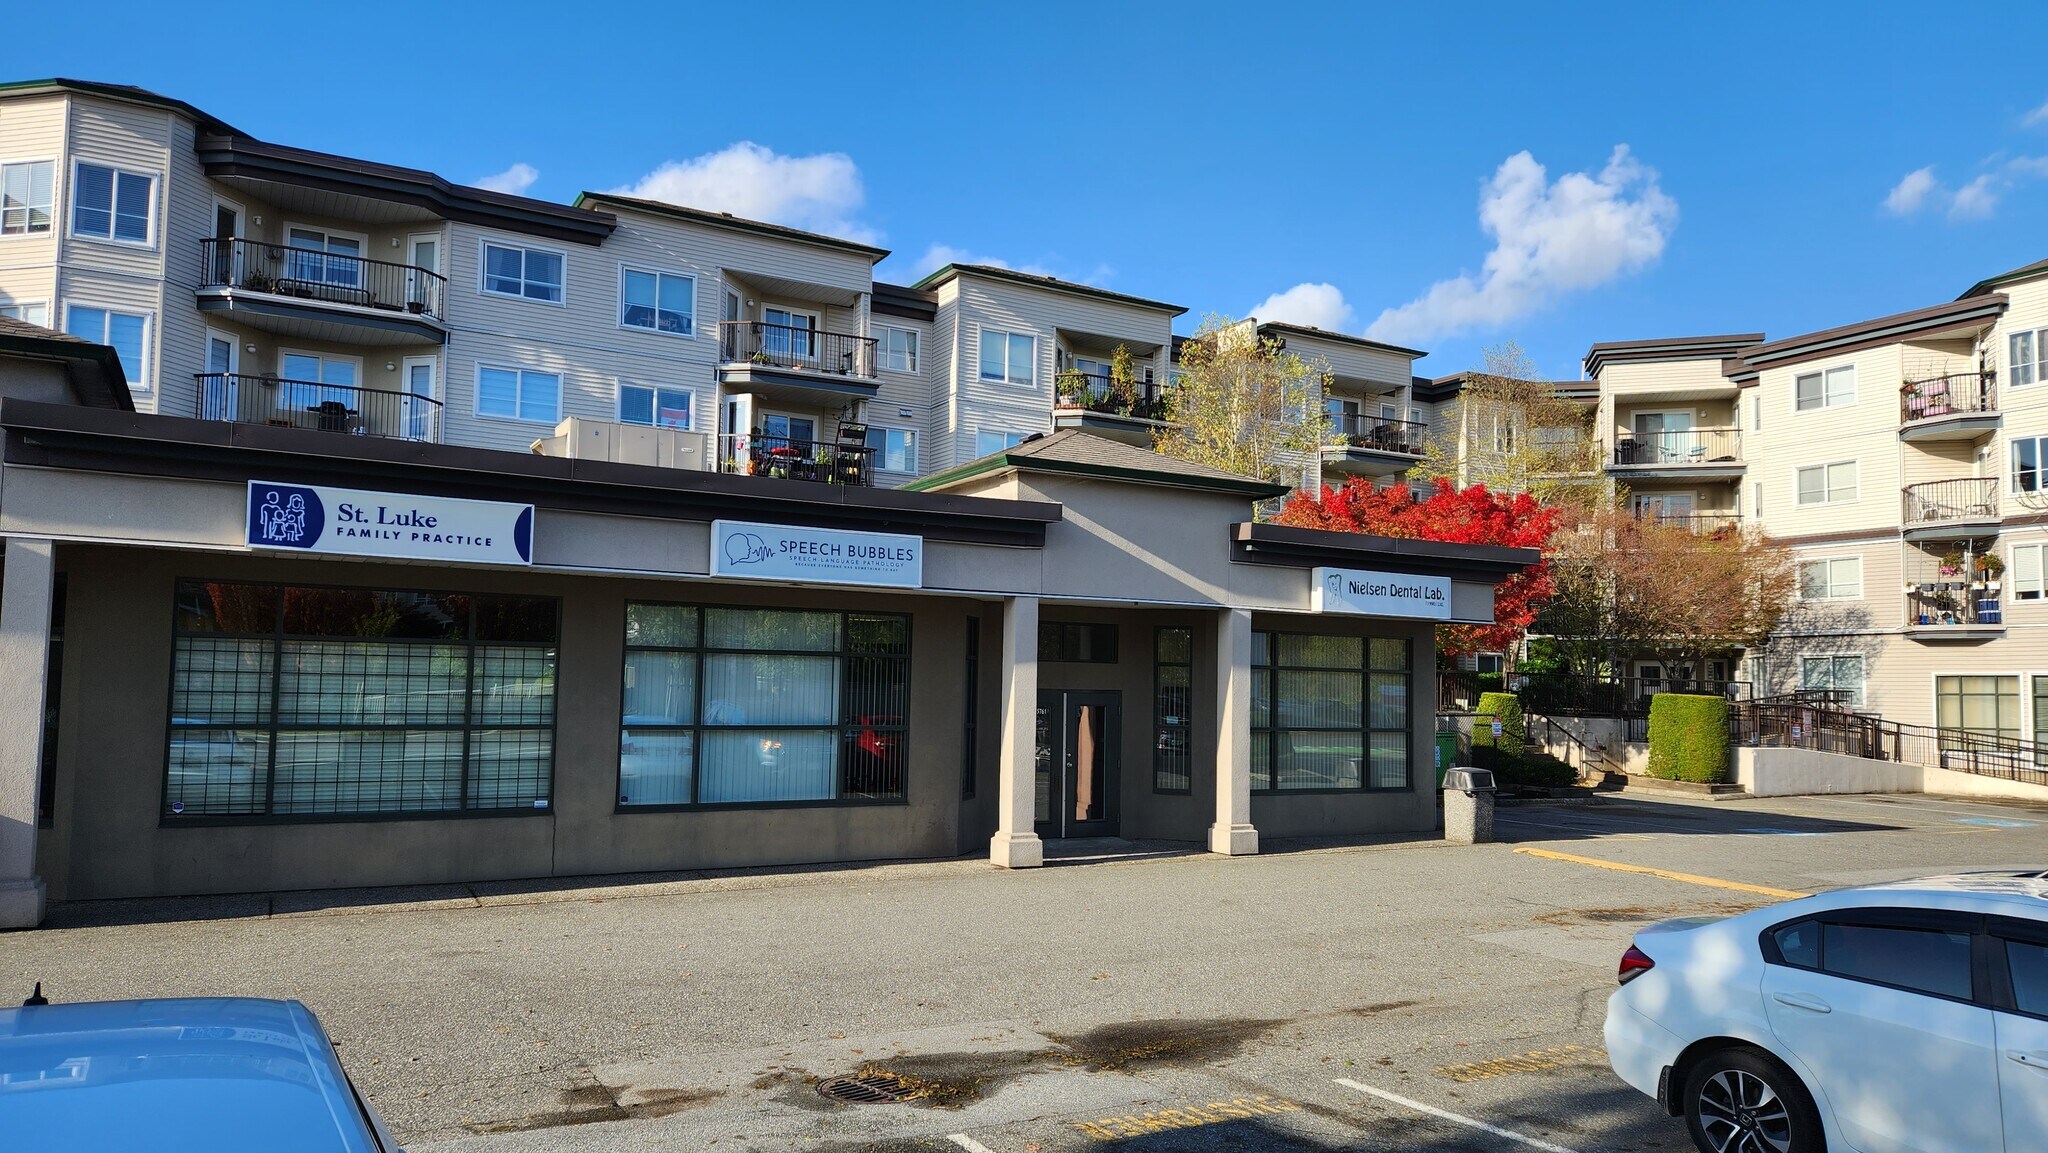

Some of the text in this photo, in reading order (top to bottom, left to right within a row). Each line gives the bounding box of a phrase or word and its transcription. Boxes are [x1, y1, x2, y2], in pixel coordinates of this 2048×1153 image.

[337, 502, 438, 528] St. Luke
[336, 526, 492, 547] FAMILY PRACTICE
[779, 540, 914, 561] SPEECH BUBBLES
[863, 560, 904, 568] PATHOLOGY
[1349, 581, 1445, 601] Nielsen Dental Lab.
